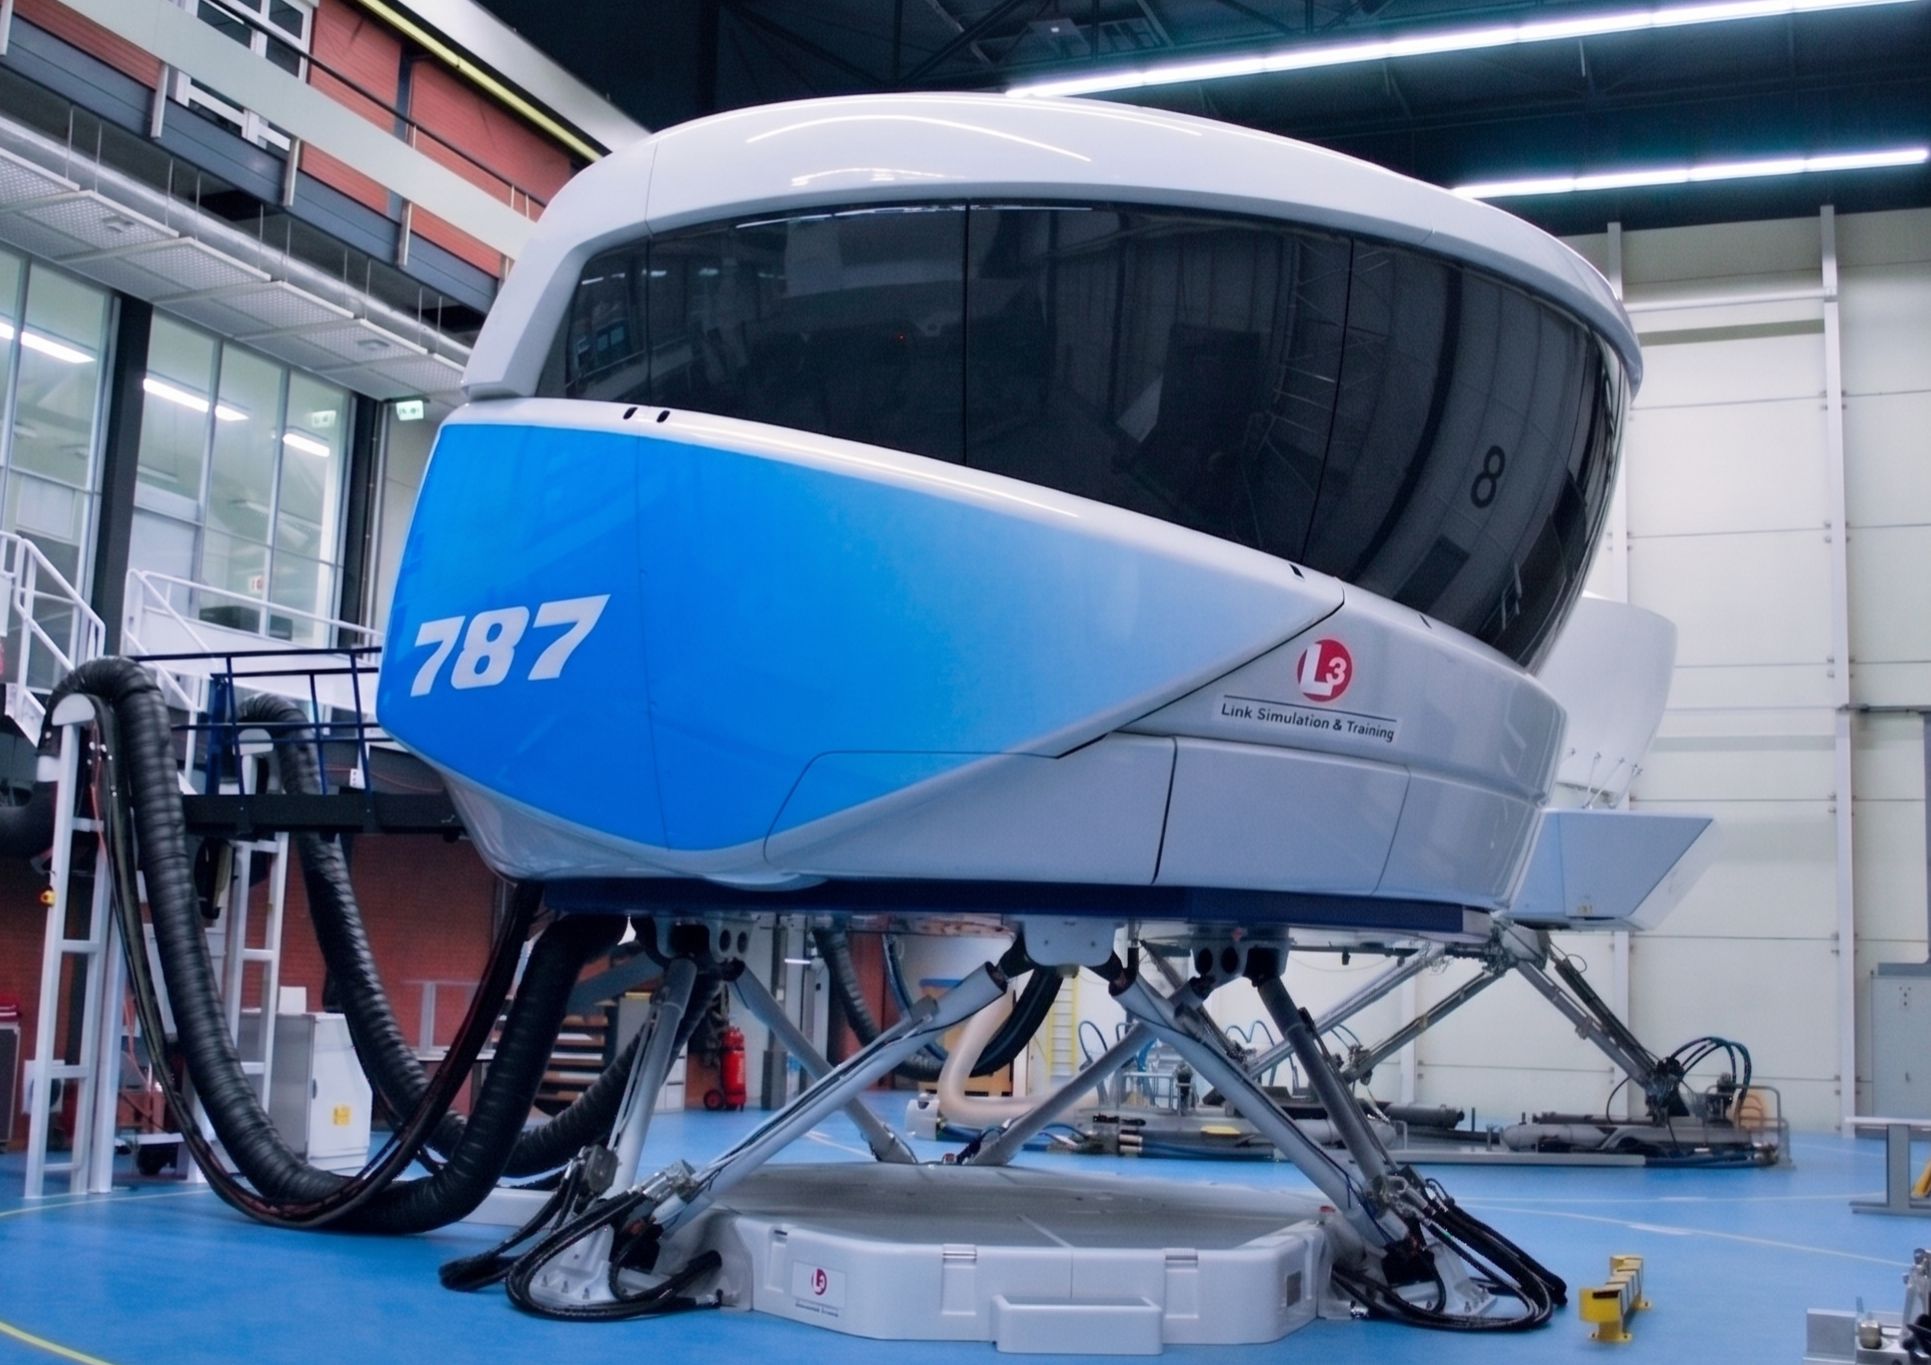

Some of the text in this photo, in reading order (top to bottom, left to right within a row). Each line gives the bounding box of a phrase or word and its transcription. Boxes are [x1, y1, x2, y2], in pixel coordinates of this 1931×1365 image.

[410, 594, 611, 697] 787
[1300, 643, 1347, 696] L3
[1221, 703, 1395, 743] Link Simulation & Training
